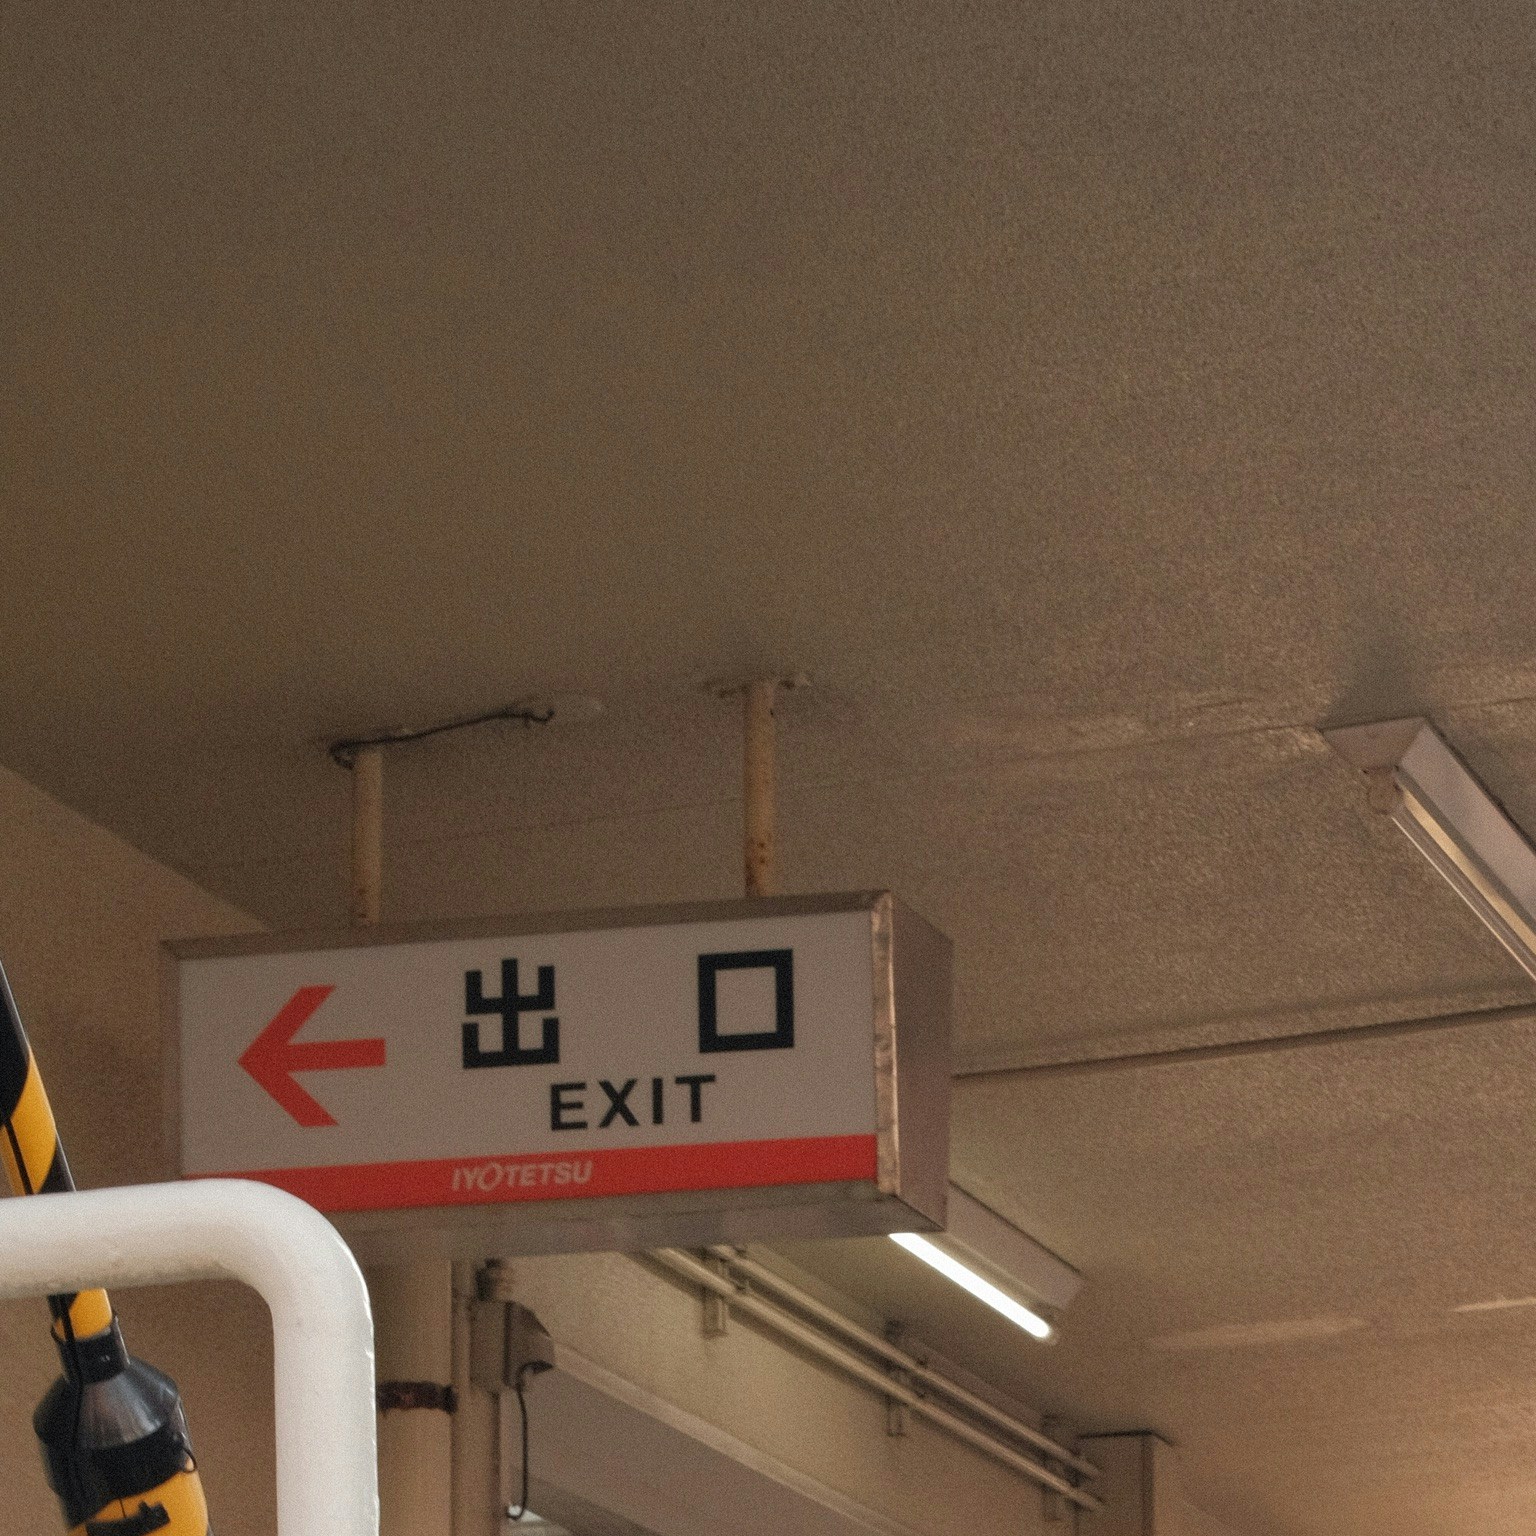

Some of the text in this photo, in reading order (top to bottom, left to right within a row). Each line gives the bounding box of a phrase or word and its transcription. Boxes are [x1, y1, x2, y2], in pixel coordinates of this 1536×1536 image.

[461, 947, 795, 1070] 出口
[549, 1074, 717, 1132] EXIT
[451, 1160, 594, 1193] IYOTETSU
